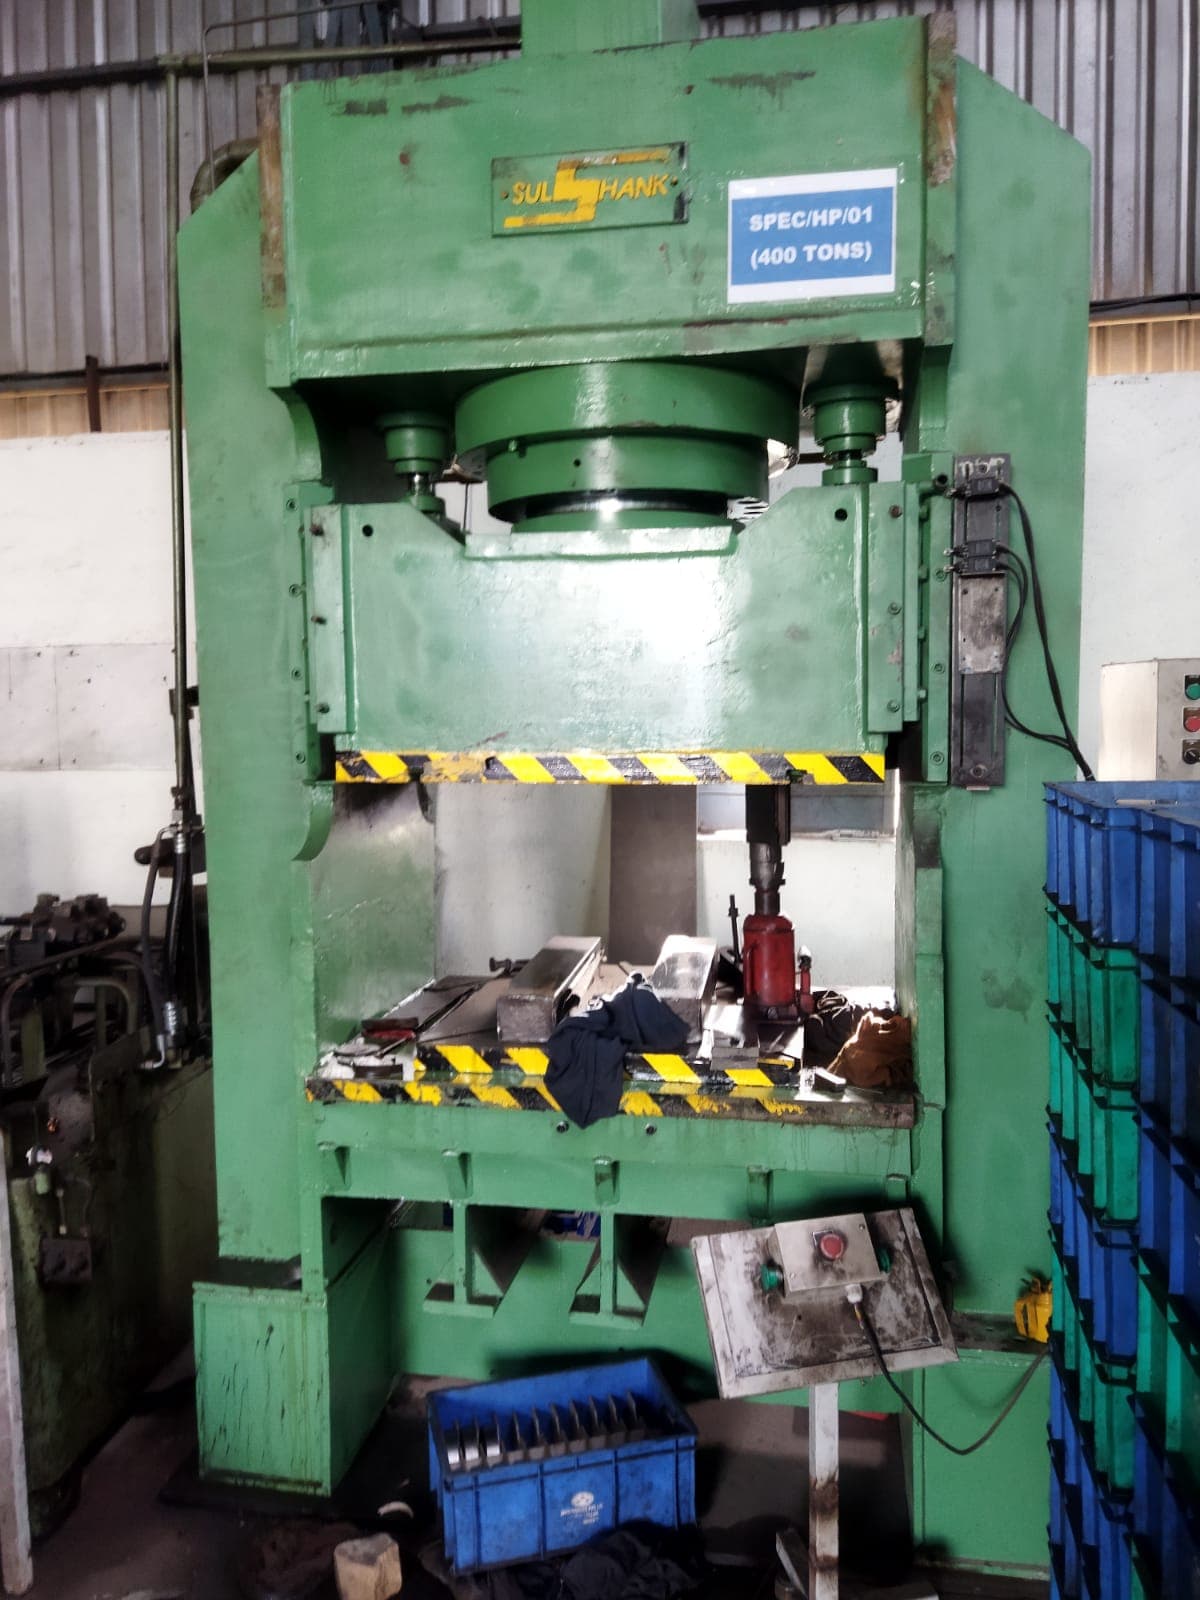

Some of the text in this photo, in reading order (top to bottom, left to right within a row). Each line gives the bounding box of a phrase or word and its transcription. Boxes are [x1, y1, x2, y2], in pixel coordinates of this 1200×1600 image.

[749, 205, 873, 232] SPEC/HP/01
[750, 240, 872, 271] (400 TONS)
